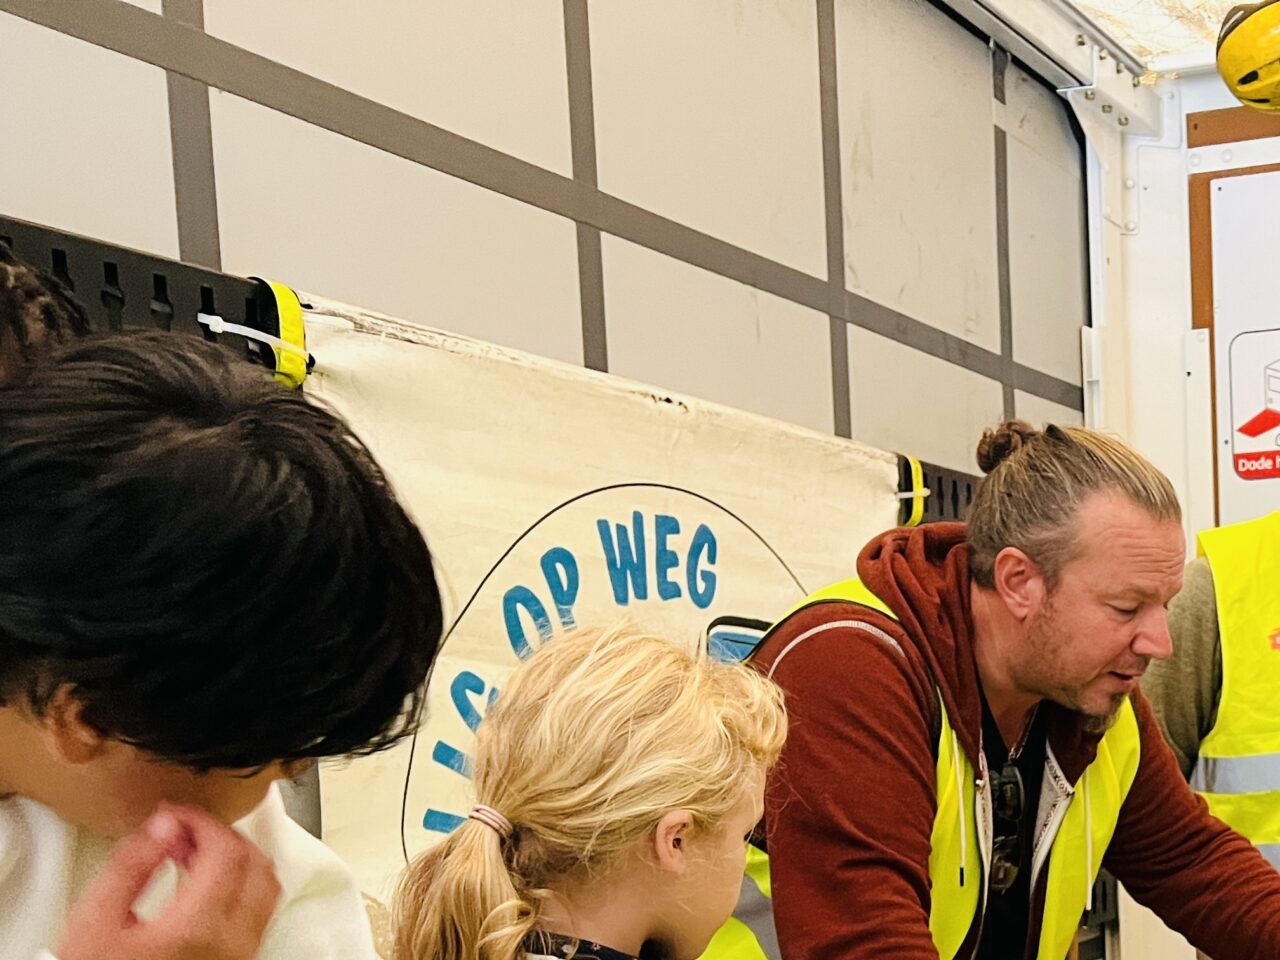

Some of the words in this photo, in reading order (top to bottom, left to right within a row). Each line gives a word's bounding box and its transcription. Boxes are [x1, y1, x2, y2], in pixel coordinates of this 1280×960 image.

[1238, 456, 1274, 472] Dode
[502, 546, 580, 664] OP
[597, 511, 718, 609] WEG
